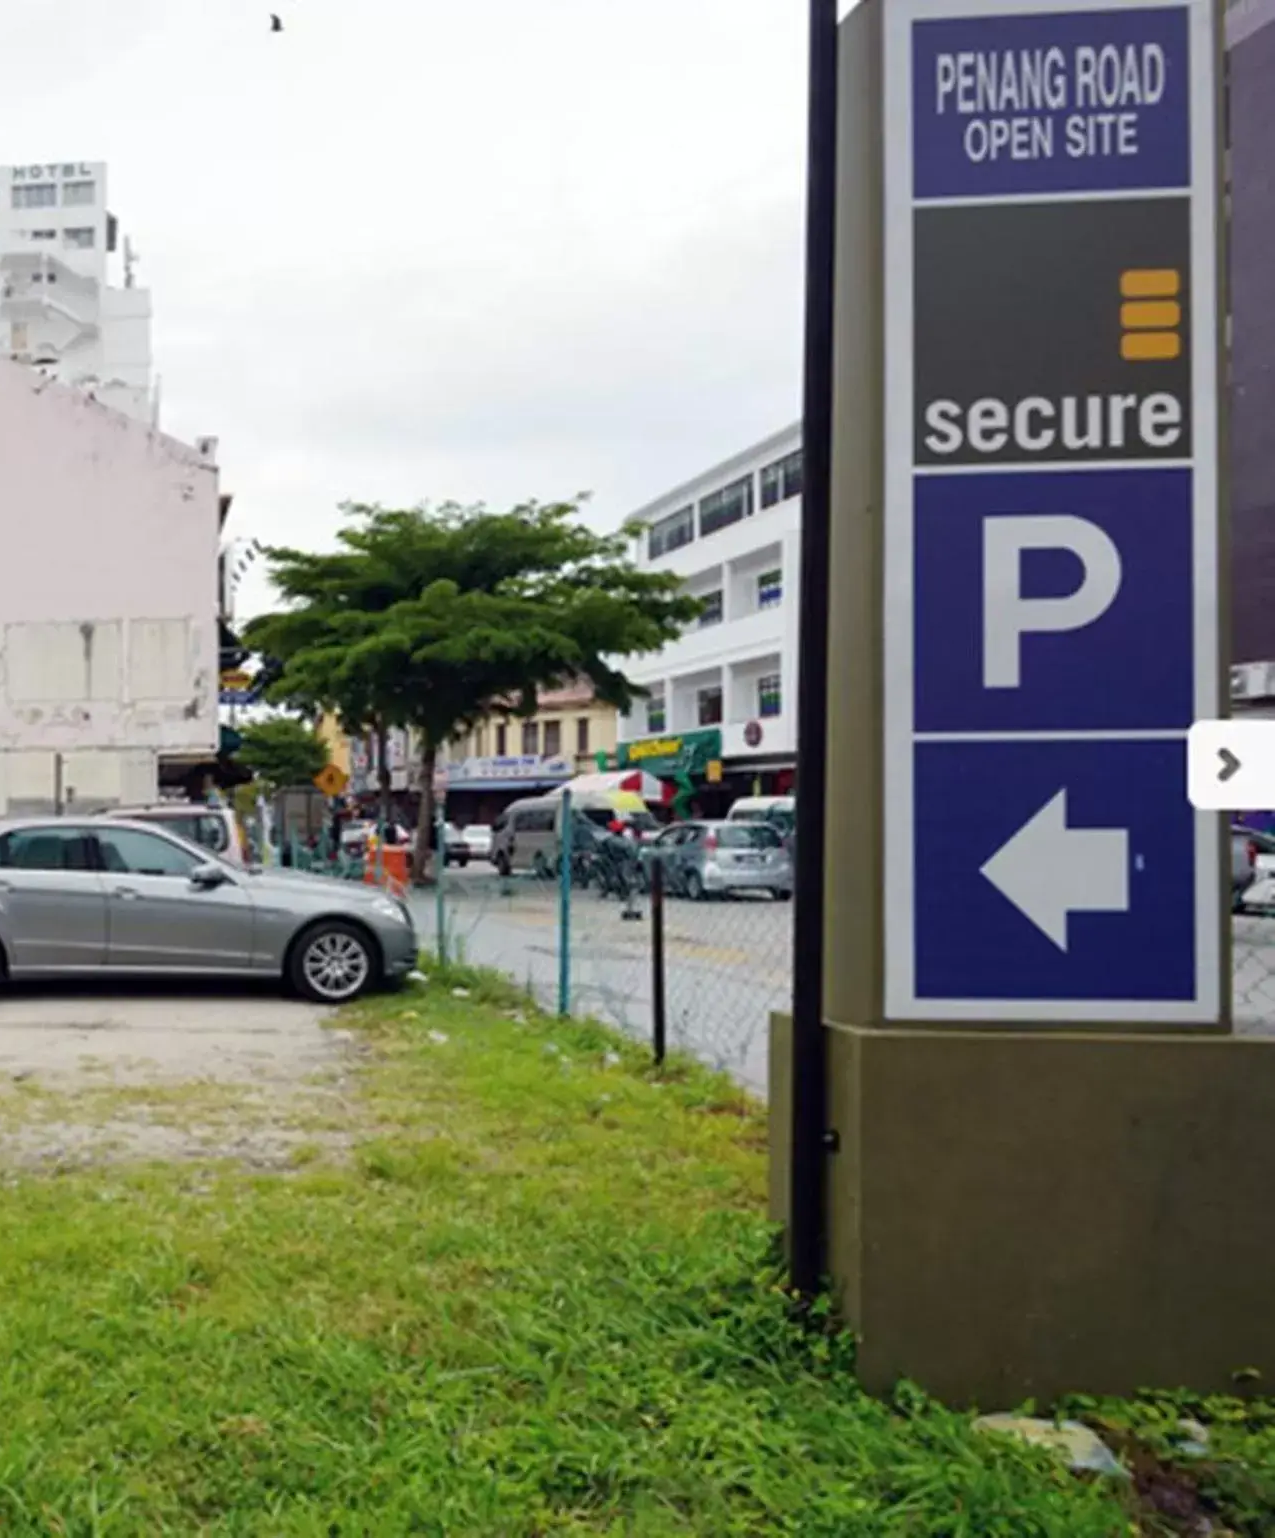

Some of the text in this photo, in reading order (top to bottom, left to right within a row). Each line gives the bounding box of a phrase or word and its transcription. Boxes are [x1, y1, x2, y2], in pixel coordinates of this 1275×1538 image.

[936, 43, 1166, 114] PENANG ROAD
[964, 113, 1138, 162] OPEN SITE
[924, 392, 1182, 453] secure
[982, 514, 1122, 688] P
